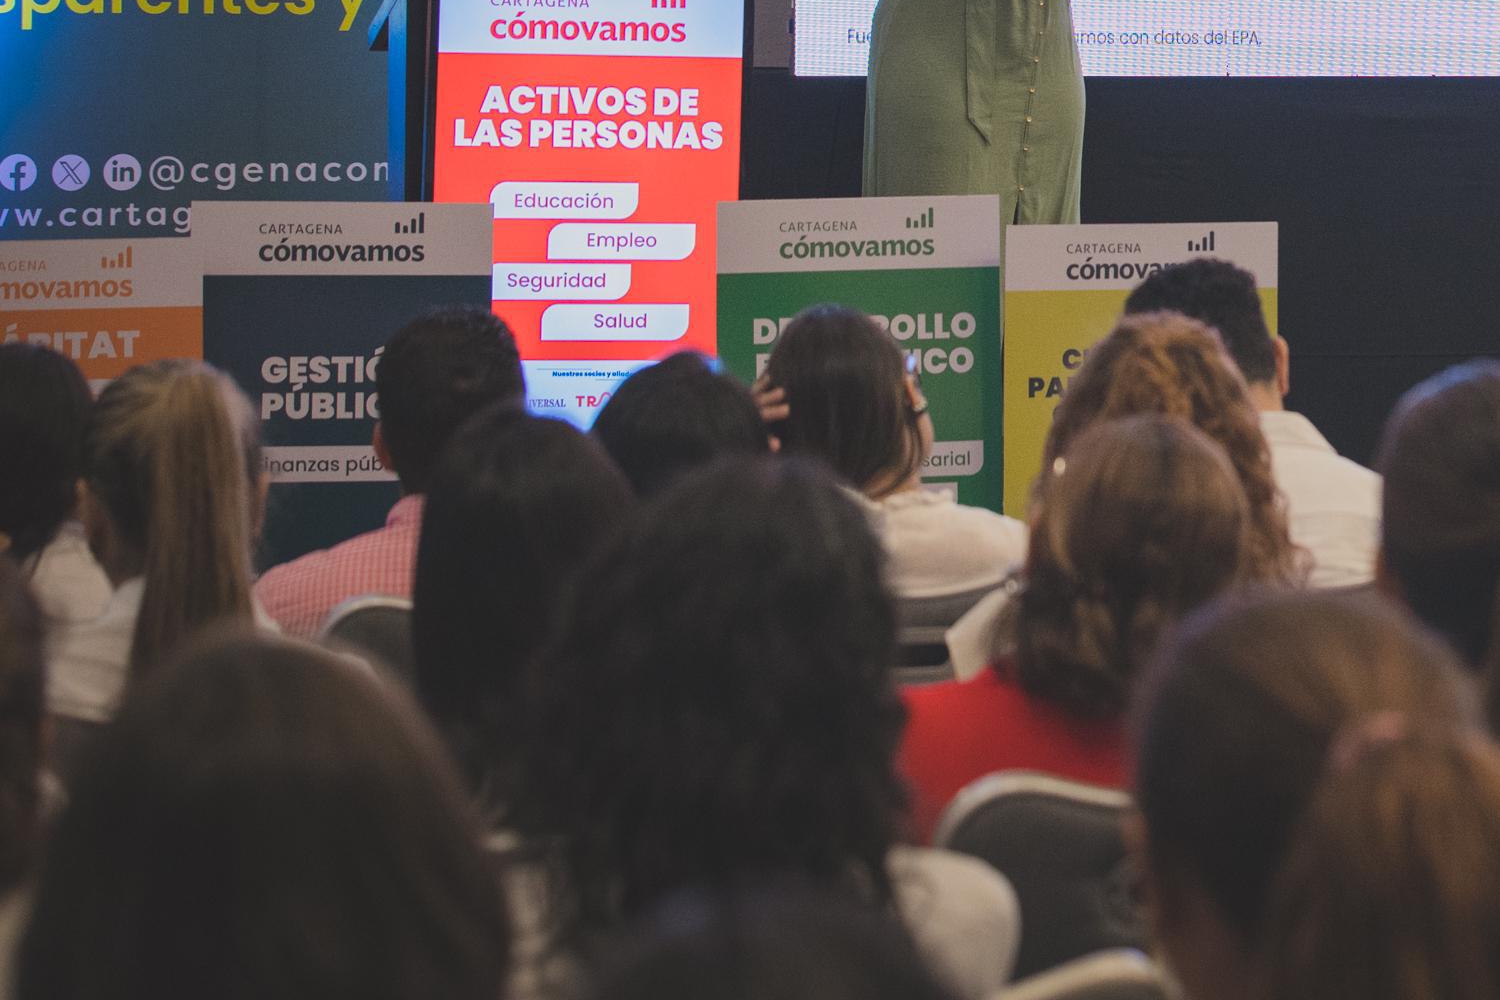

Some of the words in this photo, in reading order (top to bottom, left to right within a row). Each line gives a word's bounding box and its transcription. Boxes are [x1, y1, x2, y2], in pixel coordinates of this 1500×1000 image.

[490, 11, 686, 43] cómovamos
[480, 85, 647, 116] ACTIVOS
[654, 89, 699, 116] DE
[454, 119, 522, 148] LAS
[529, 119, 723, 150] PERSONAS
[514, 192, 614, 209] Educación
[259, 223, 343, 234] CARTAGENA
[779, 220, 858, 233] CARTAGENA
[258, 238, 425, 262] cómovamos
[587, 232, 657, 252] Empleo
[779, 235, 935, 259] cómovamos
[1066, 242, 1142, 255] CARTAGENA
[507, 273, 606, 292] Seguridad
[594, 314, 647, 328] Salud
